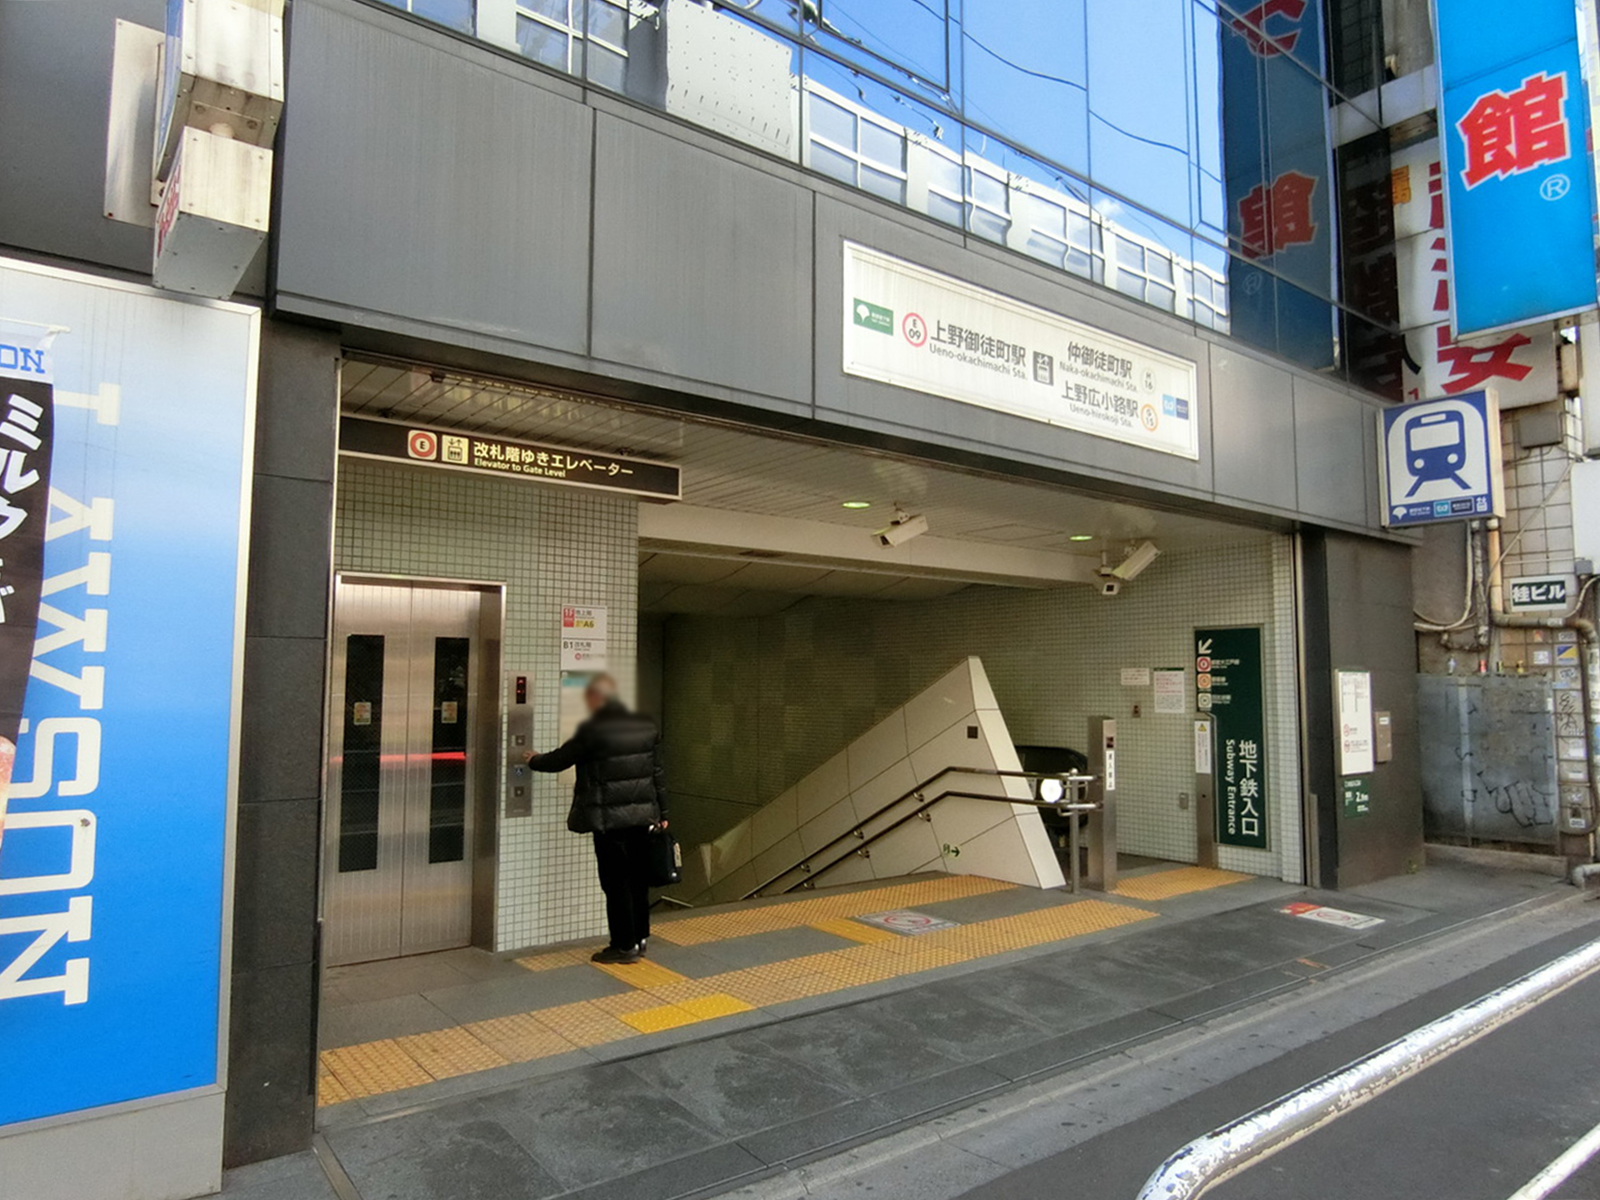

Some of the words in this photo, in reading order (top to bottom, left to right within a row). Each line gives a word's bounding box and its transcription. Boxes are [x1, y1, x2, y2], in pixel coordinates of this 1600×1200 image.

[1455, 70, 1572, 191] 館
[908, 328, 922, 341] 09
[930, 319, 1027, 368] 上野御徒町駅
[929, 343, 1012, 376] Ueno-okachimachi
[1012, 365, 1028, 380] Sta.
[1059, 361, 1126, 388] Naka-okachimachi
[1067, 341, 1133, 380] 仲御徒町駅
[1061, 380, 1140, 419] 上野広小路駅
[473, 441, 634, 476] 改札階ゆきエレベーター
[473, 457, 510, 471] Elevator
[511, 463, 522, 472] to
[523, 464, 543, 476] Gate
[544, 467, 567, 479] Level
[1225, 738, 1236, 783] Subway
[1239, 739, 1259, 837] 地下鉄入口
[1226, 785, 1238, 836] Entrance
